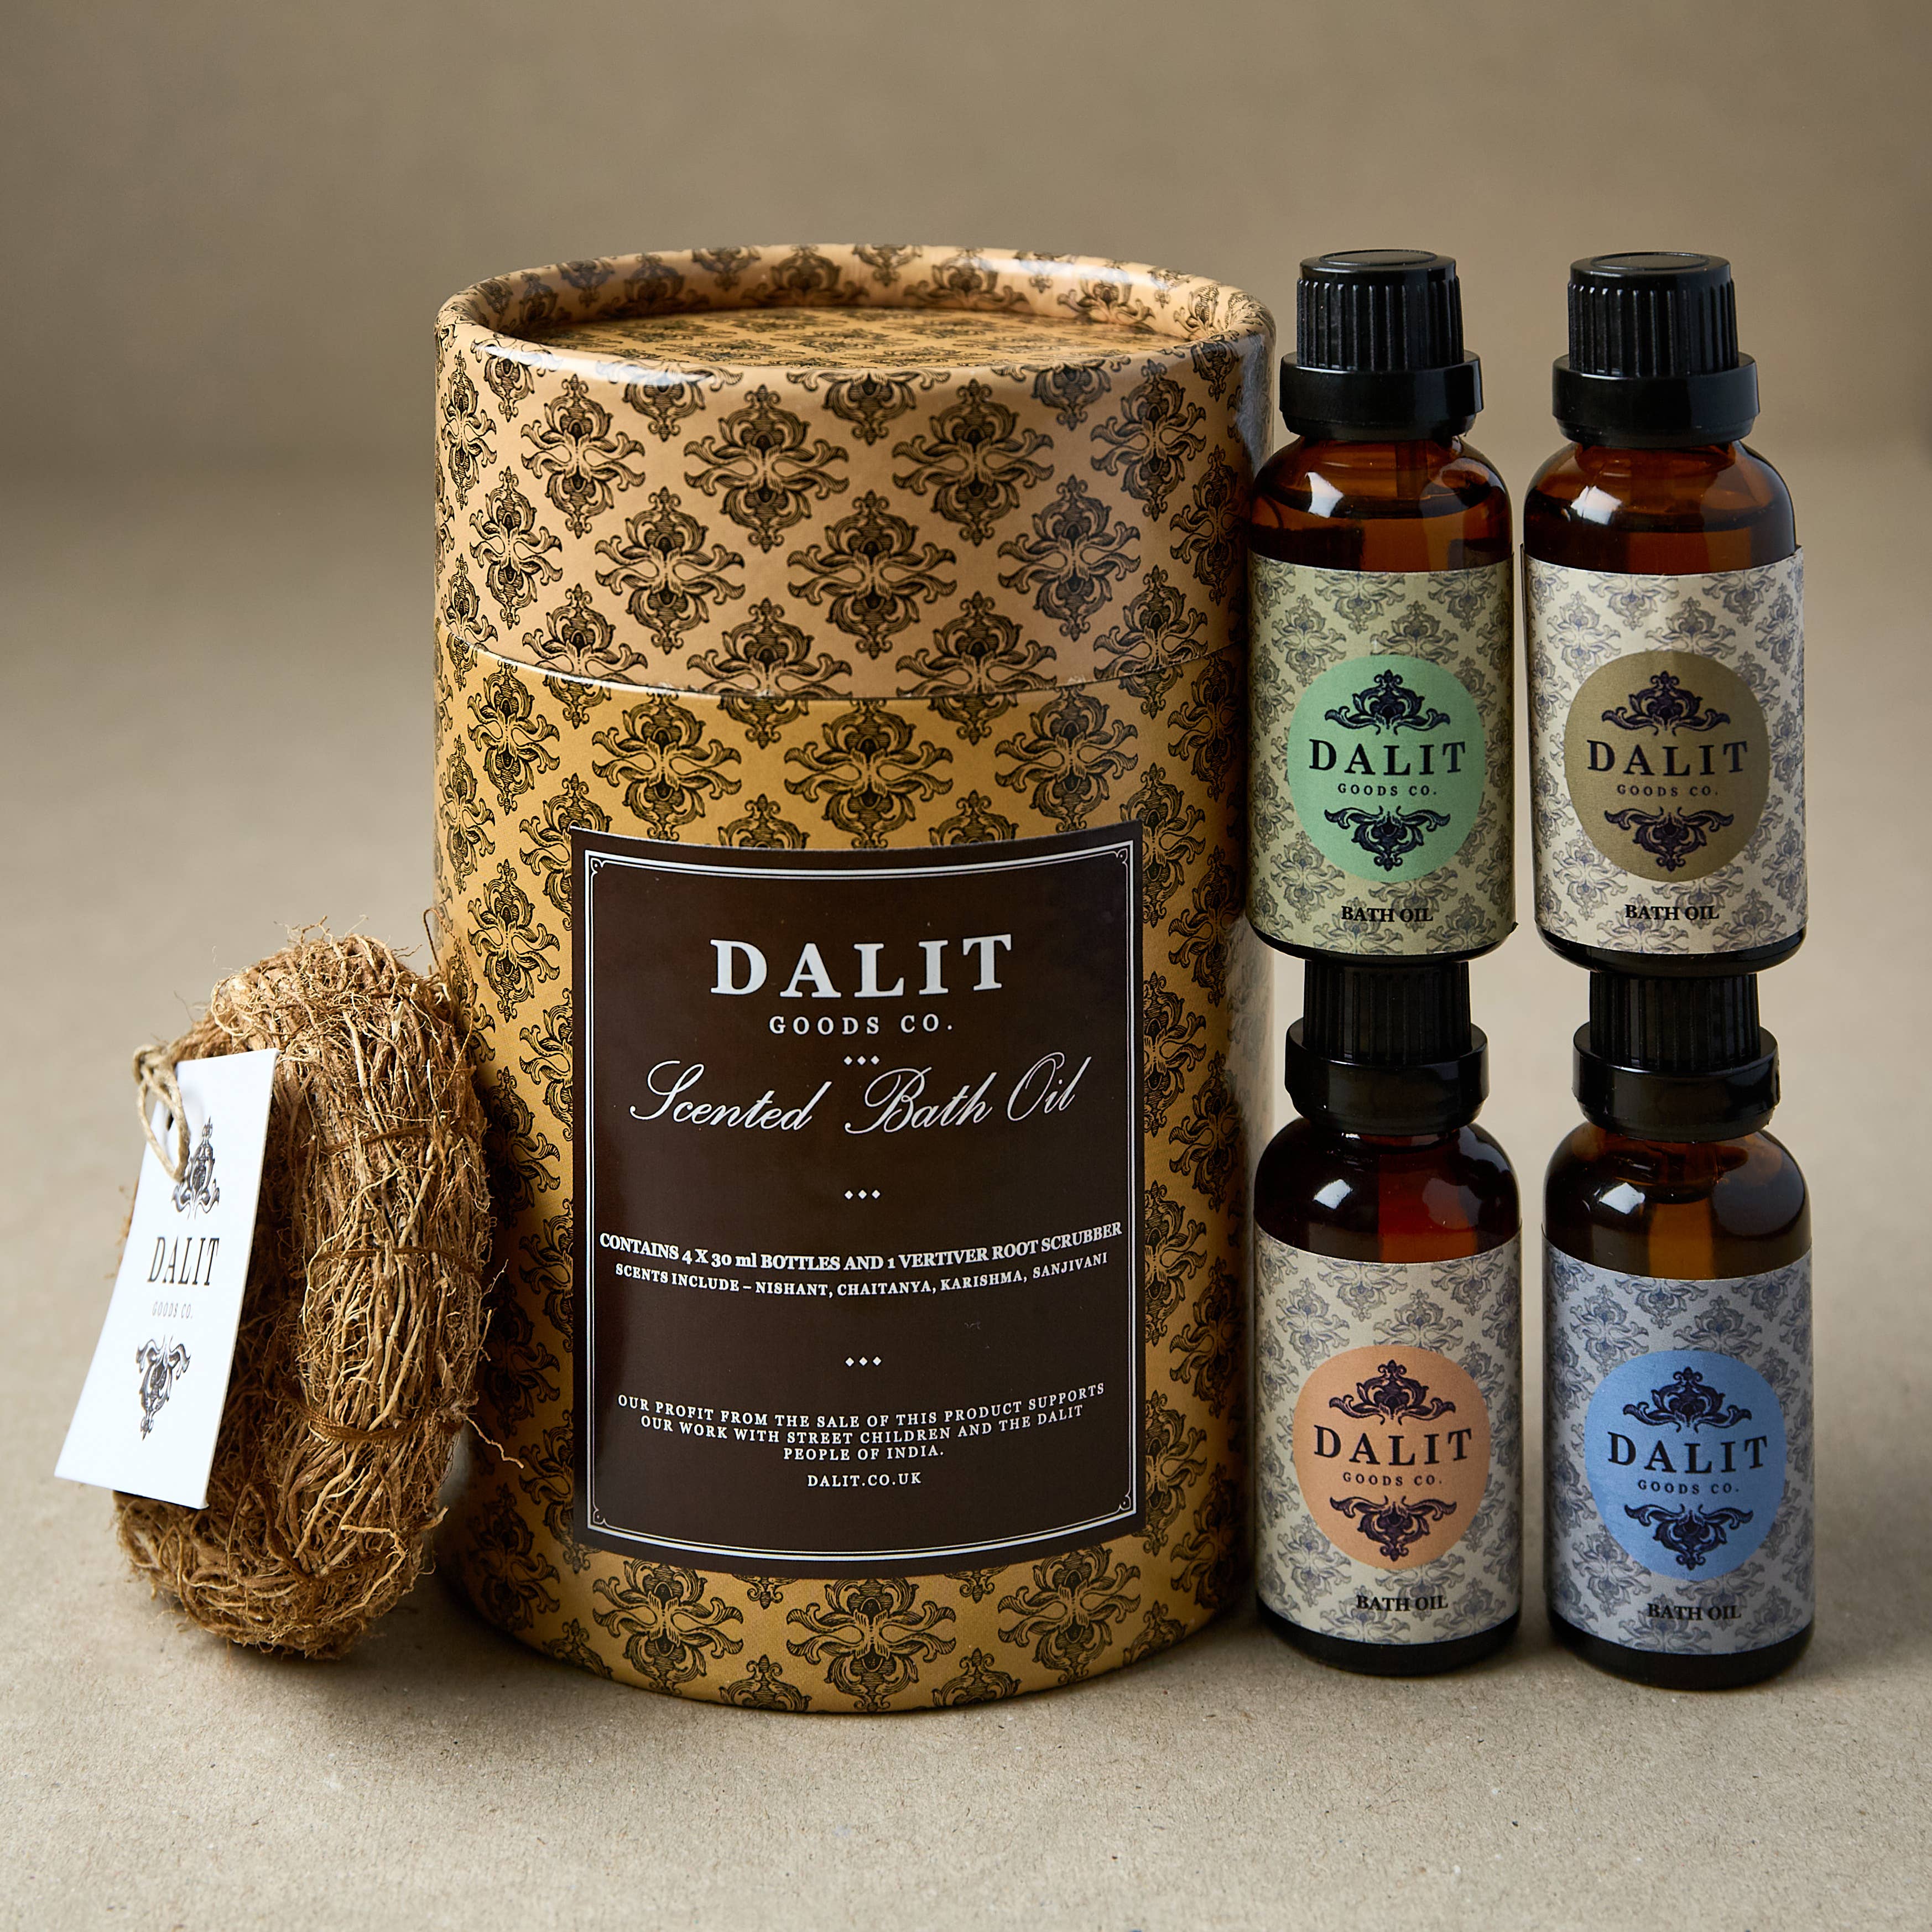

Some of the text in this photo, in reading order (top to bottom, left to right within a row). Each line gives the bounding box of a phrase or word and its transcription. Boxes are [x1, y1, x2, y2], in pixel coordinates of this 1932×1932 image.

[1309, 738, 1466, 776] DALIT
[1586, 737, 1751, 778] DALIT
[1337, 783, 1437, 796] GOODS CO.
[1617, 784, 1719, 798] GOODS CO.
[1341, 904, 1434, 924] BATH OIL
[1624, 903, 1721, 921] BATH OIL
[710, 934, 1012, 998] DALIT
[769, 1013, 952, 1035] GOODS CO.
[629, 1051, 1092, 1134] Scented Bath Oil
[600, 1221, 1122, 1270] CONTAINS 4 X 30 ml BOTTLES AND 1 VERTIVER ROOT SCRUBBER
[148, 1237, 220, 1286] DALIT
[616, 1263, 669, 1284] SCENTS
[671, 1273, 740, 1292] INCLUDE
[755, 1281, 833, 1298] NISHANT,
[837, 1280, 936, 1296] CHAITANYA,
[940, 1270, 1027, 1291] KARISHMA,
[1033, 1252, 1107, 1279] SANJIVANI
[152, 1301, 179, 1318] GOODS
[618, 1383, 1104, 1428] OUR PROFIT FROM THE SALE OF THIS PRODUCT SUPPORTS
[641, 1403, 1083, 1444] OUR WORK WITH STREET CHILDREN AND THE DALIT
[783, 1445, 944, 1461] PEOPLE OF INDIA.
[1314, 1424, 1472, 1466] DALIT
[1607, 1430, 1769, 1476] DALIT
[808, 1472, 921, 1487] DALIT.CO.UK
[1342, 1472, 1442, 1487] GOODS CO.
[1637, 1479, 1740, 1496] GOODS CO.
[1356, 1593, 1449, 1612] BATH OIL
[1647, 1602, 1742, 1623] BATH OIL
